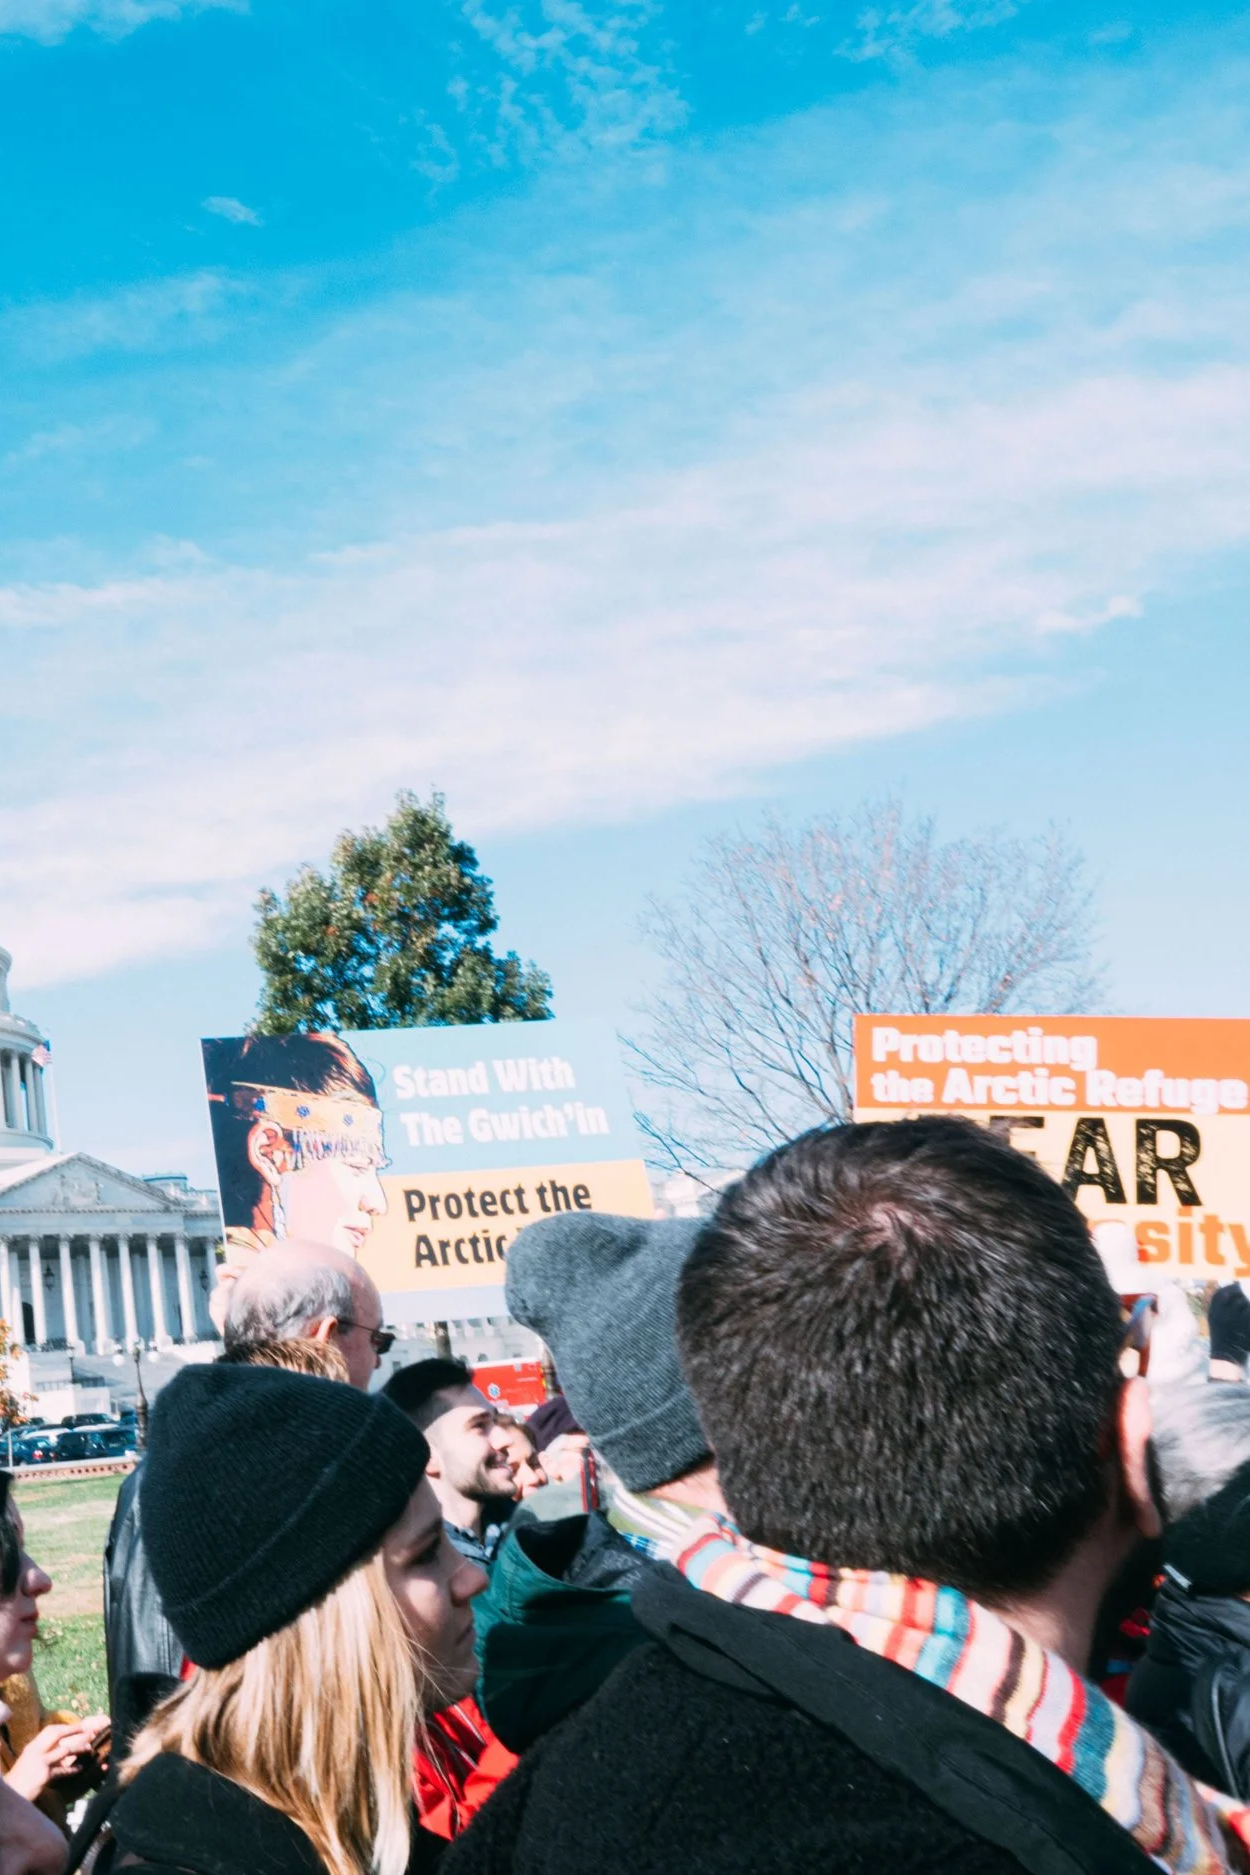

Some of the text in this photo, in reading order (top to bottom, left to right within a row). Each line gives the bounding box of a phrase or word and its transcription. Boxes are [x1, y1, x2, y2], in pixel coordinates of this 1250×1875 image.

[871, 1027, 1097, 1070] Protecting
[393, 1056, 576, 1099] Stand With
[871, 1068, 1248, 1115] the Arctic Refuge
[399, 1101, 611, 1147] The Gwich'in
[403, 1179, 592, 1222] Protect the
[414, 1229, 508, 1268] Arctic
